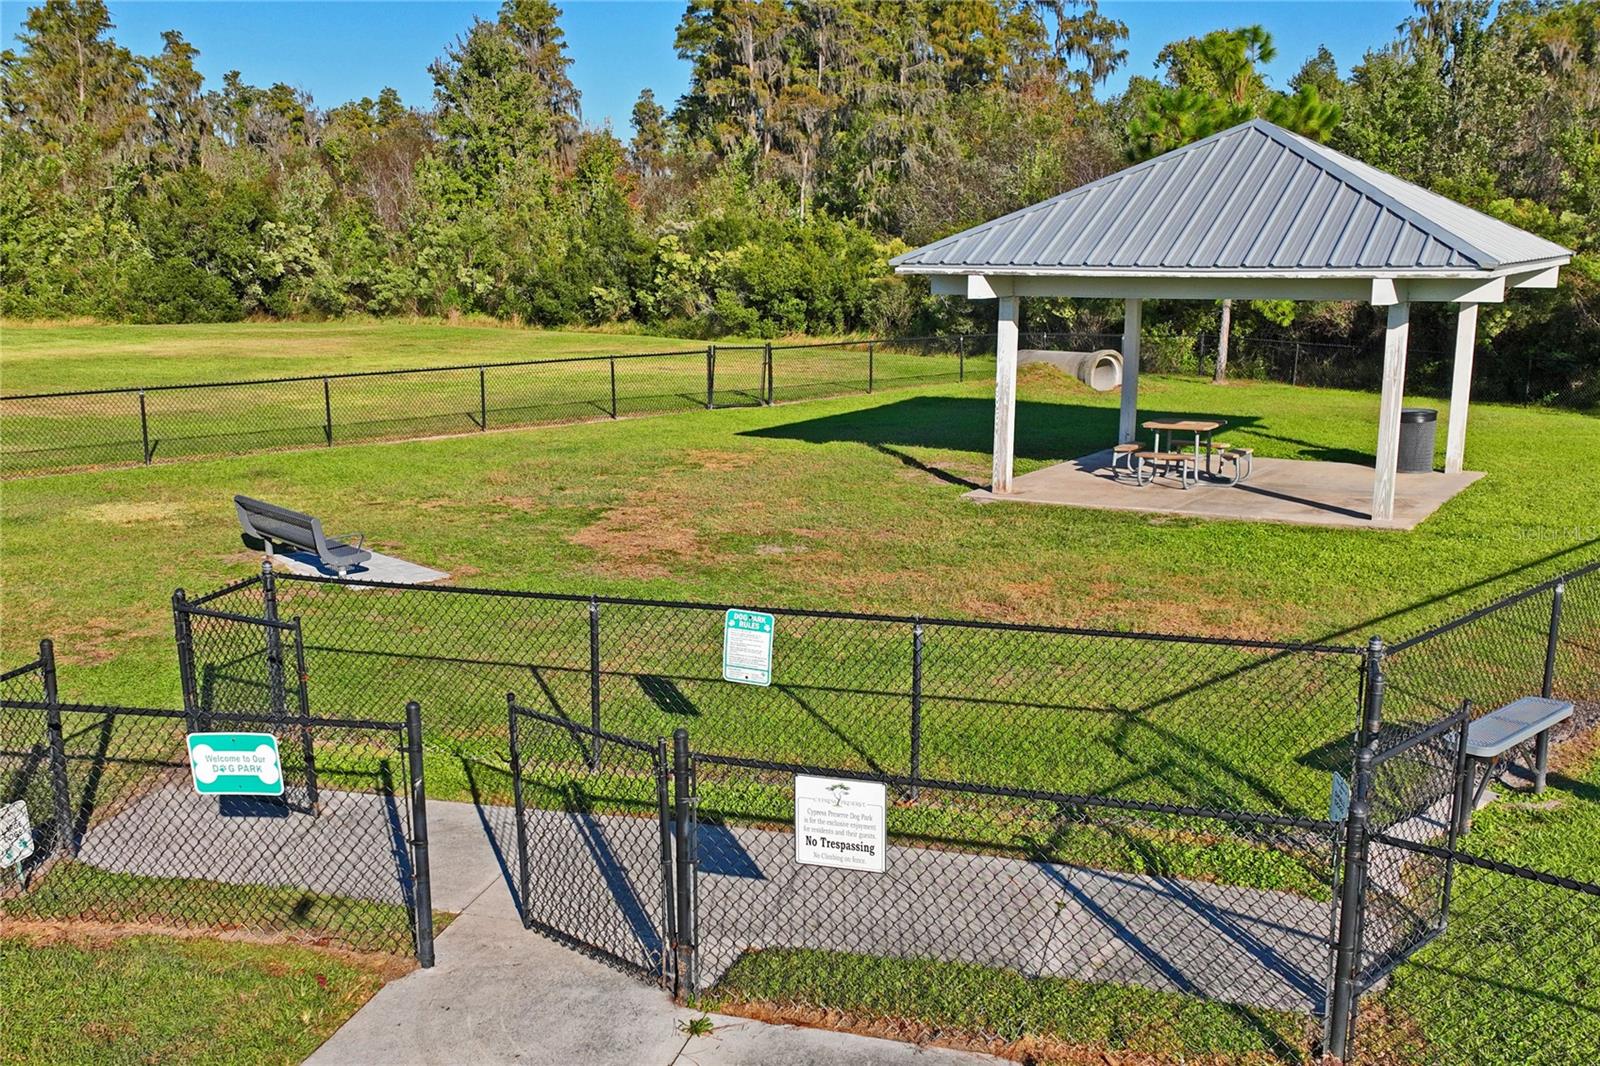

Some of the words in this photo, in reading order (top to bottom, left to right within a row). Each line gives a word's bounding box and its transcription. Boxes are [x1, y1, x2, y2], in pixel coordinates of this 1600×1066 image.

[734, 612, 748, 621] DOG
[739, 620, 760, 630] RULES
[205, 754, 240, 763] Welcome
[242, 755, 251, 763] to
[252, 755, 266, 763] Our
[212, 764, 235, 773] DOG
[238, 764, 263, 773] PARK
[806, 807, 827, 817] Cypress
[849, 812, 860, 821] Dog
[861, 813, 873, 821] Park
[811, 826, 834, 834] residents
[826, 819, 849, 828] exclusive
[850, 822, 877, 831] enjoyment
[805, 835, 818, 846] No
[819, 836, 875, 856] Trespassing
[821, 852, 843, 863] Climbing
